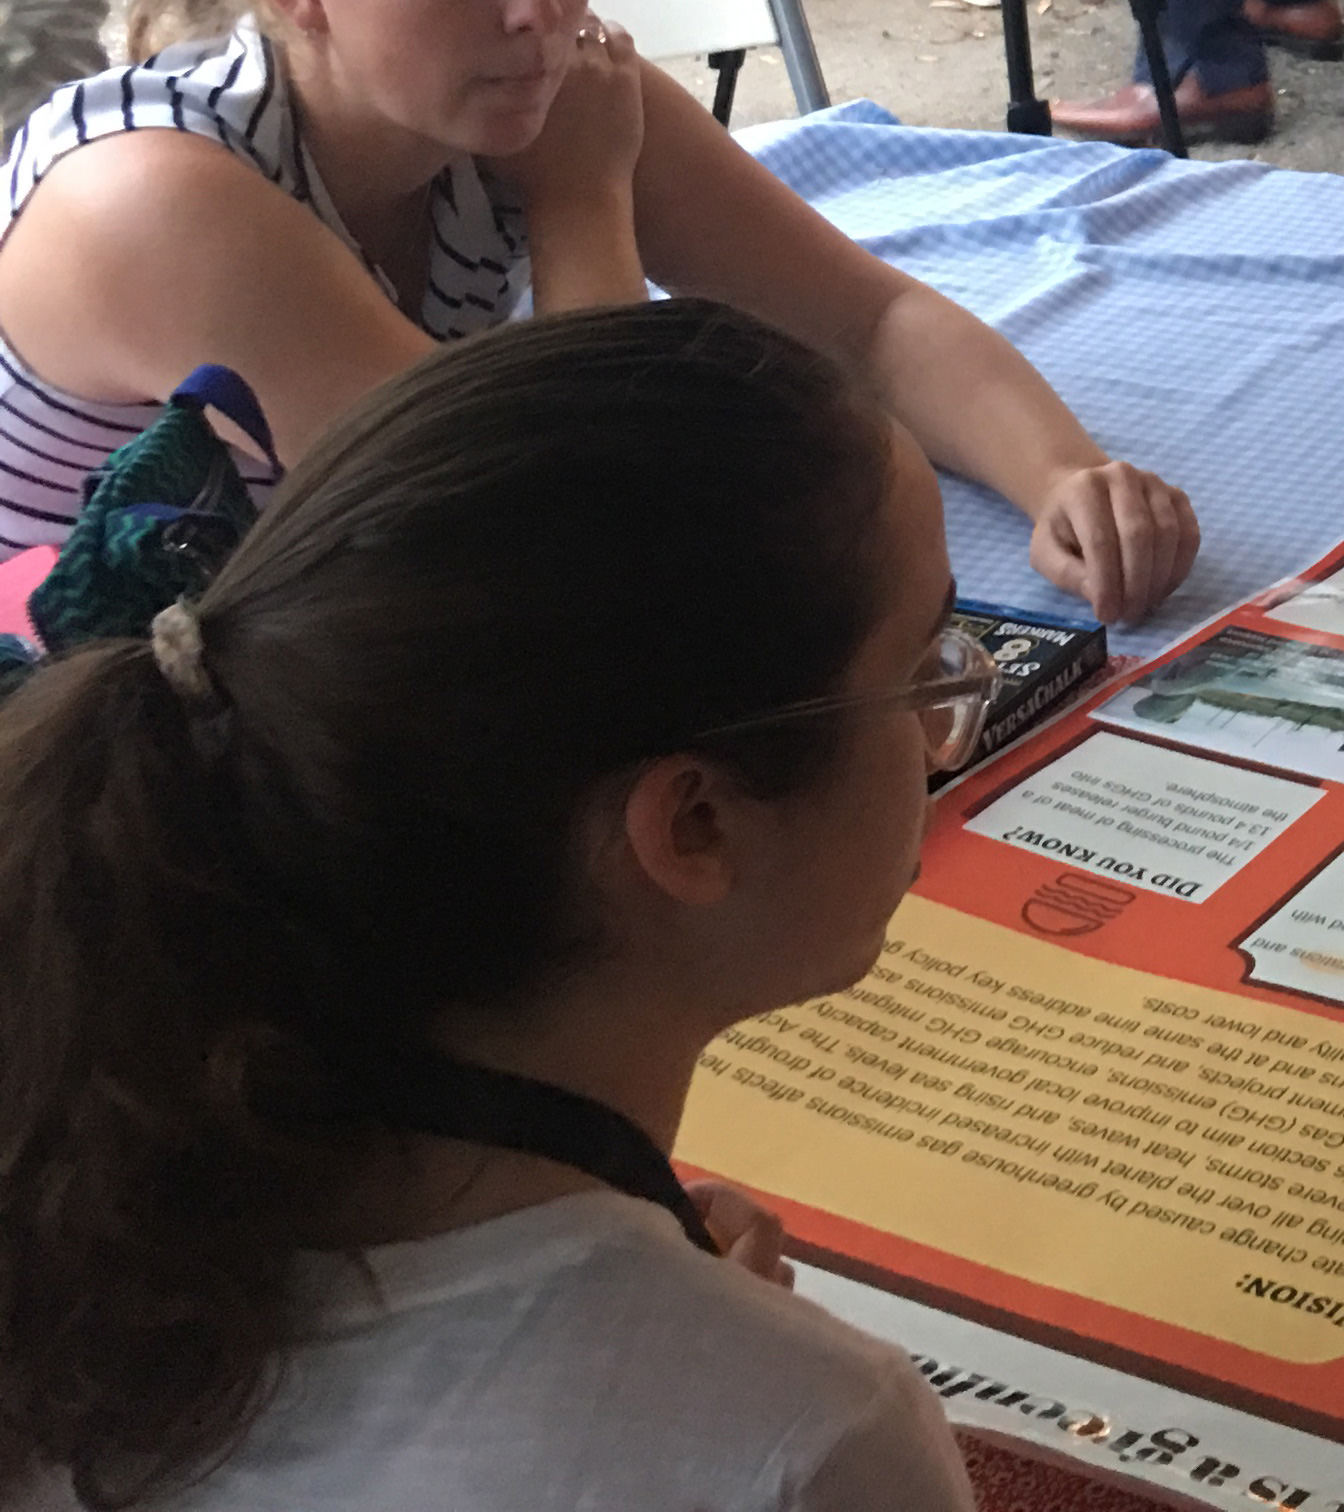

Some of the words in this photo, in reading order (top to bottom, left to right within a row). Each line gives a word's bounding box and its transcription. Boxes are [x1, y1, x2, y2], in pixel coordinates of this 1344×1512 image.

[994, 639, 1032, 662] 8
[1049, 781, 1120, 808] releases
[1118, 803, 1175, 828] burger
[1171, 821, 1229, 843] pound
[1249, 937, 1288, 953] and
[923, 1016, 983, 1044] GHG
[1201, 1013, 1262, 1039] lower
[1260, 1028, 1308, 1050] and
[984, 1034, 1100, 1076] encourage
[729, 1067, 806, 1104] affects
[803, 1096, 916, 1143] emissions
[1217, 1099, 1298, 1134] (GHG)
[915, 1133, 963, 1157] gas
[959, 1147, 1099, 1200] greenhouse
[1095, 1188, 1130, 1212] by
[1126, 1200, 1217, 1236] caused
[1217, 1225, 1310, 1265] change
